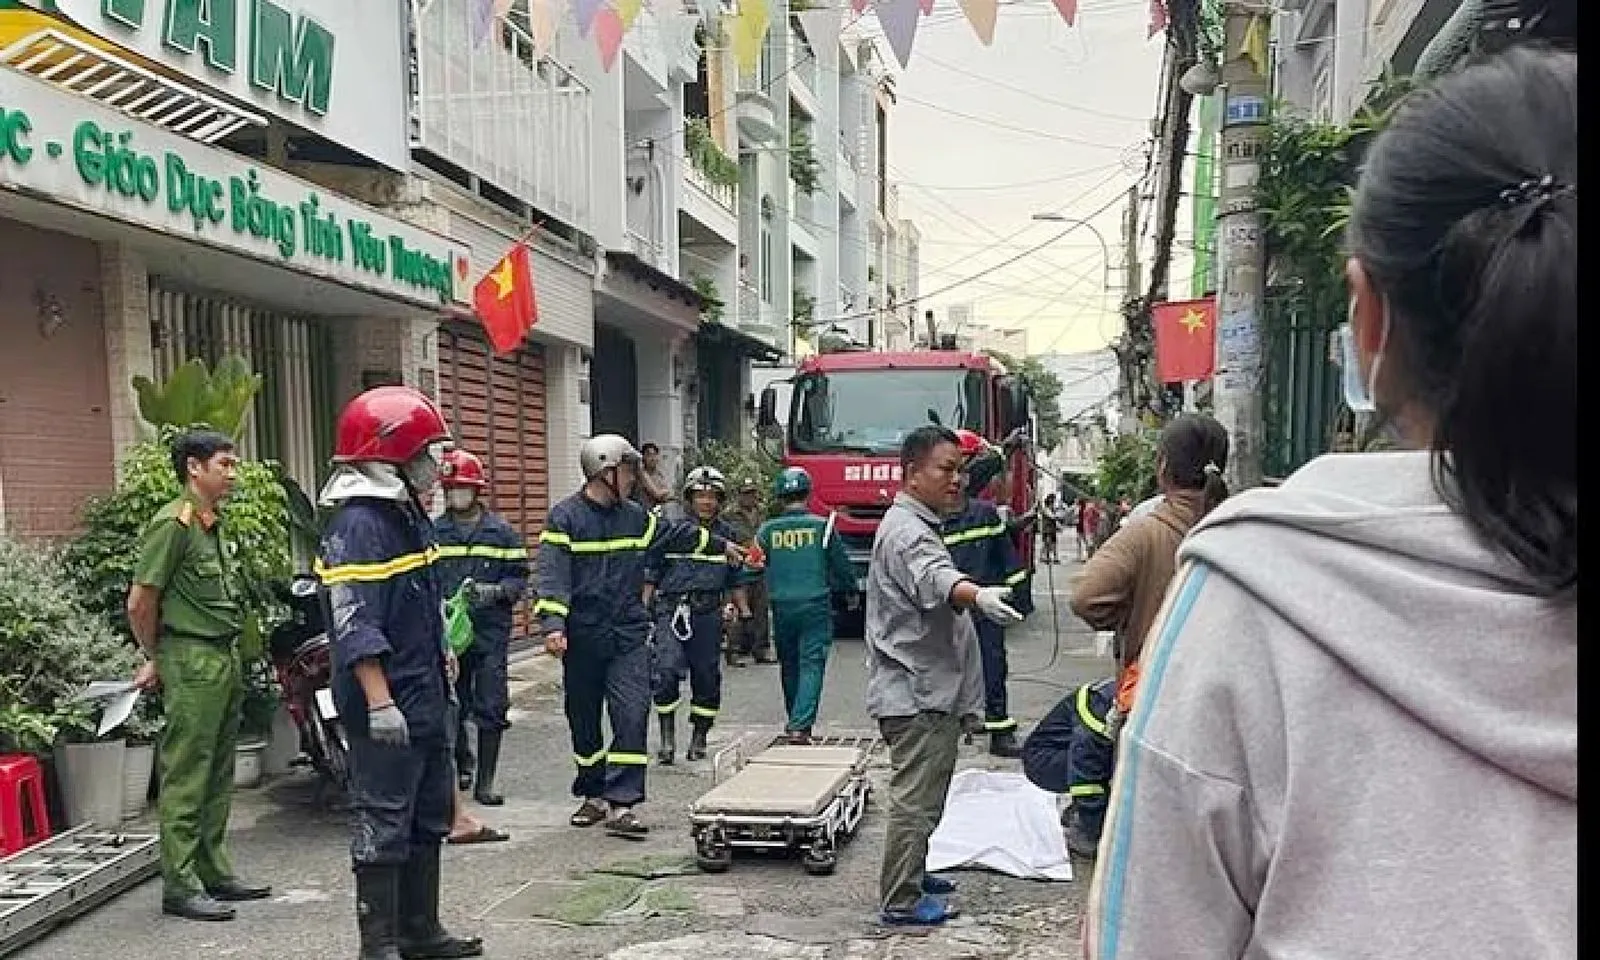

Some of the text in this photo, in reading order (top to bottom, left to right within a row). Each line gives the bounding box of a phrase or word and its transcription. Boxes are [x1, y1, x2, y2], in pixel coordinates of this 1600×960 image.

[73, 120, 159, 202] Giáo
[165, 152, 225, 231] Dục
[230, 168, 295, 258] Bằng
[772, 527, 816, 551] DQTT
